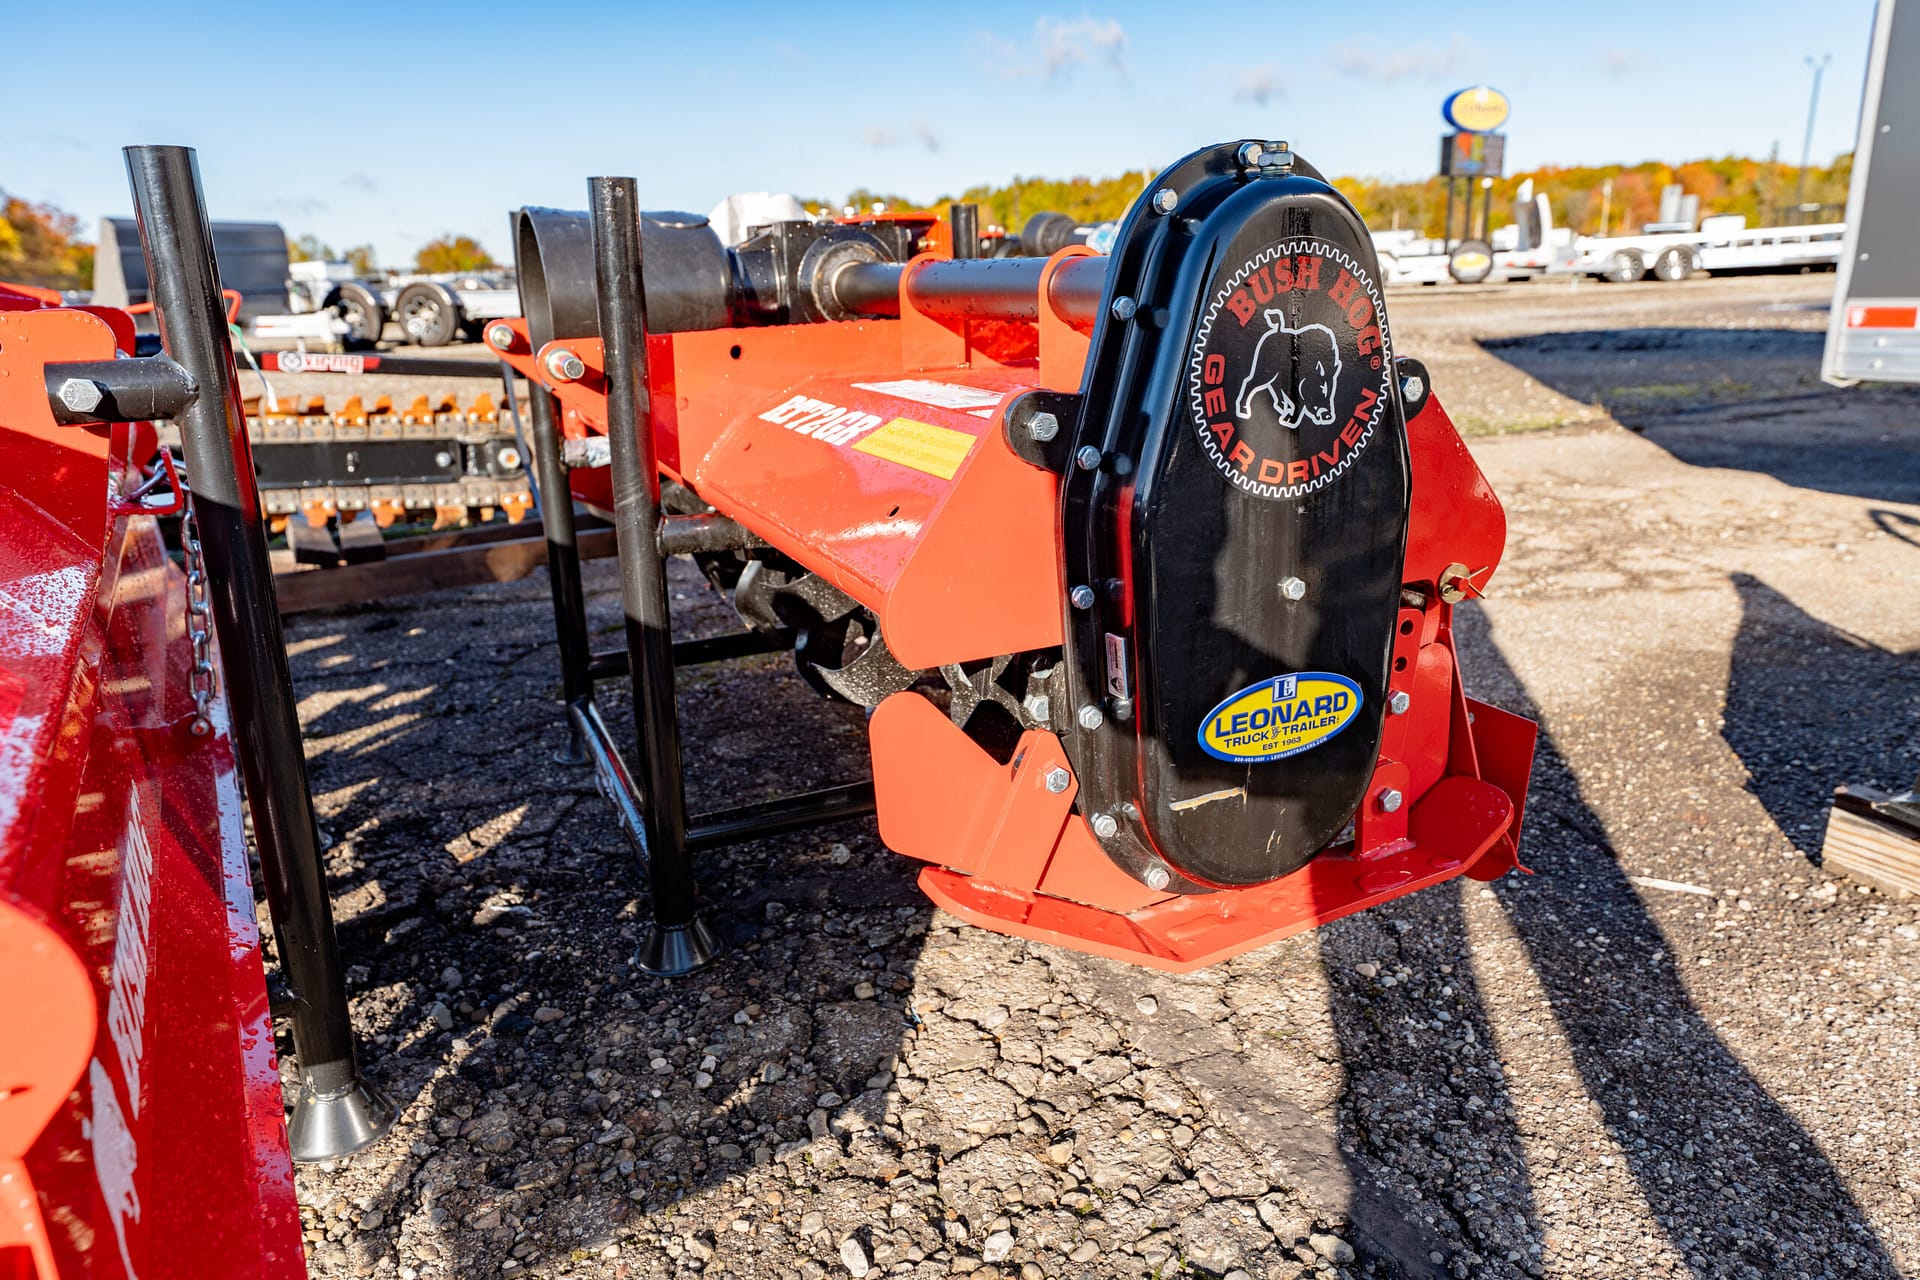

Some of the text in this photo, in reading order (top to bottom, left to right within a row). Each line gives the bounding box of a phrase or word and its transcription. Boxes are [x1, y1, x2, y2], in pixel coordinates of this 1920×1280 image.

[1226, 255, 1323, 328] BUSH
[1204, 354, 1378, 485] GEAR DRIVEN
[1215, 691, 1348, 738] LEONARD
[1224, 730, 1269, 748] TRUCK
[1282, 715, 1336, 736] TRAILER
[1262, 741, 1279, 751] EST
[107, 881, 148, 1121] BUSH
